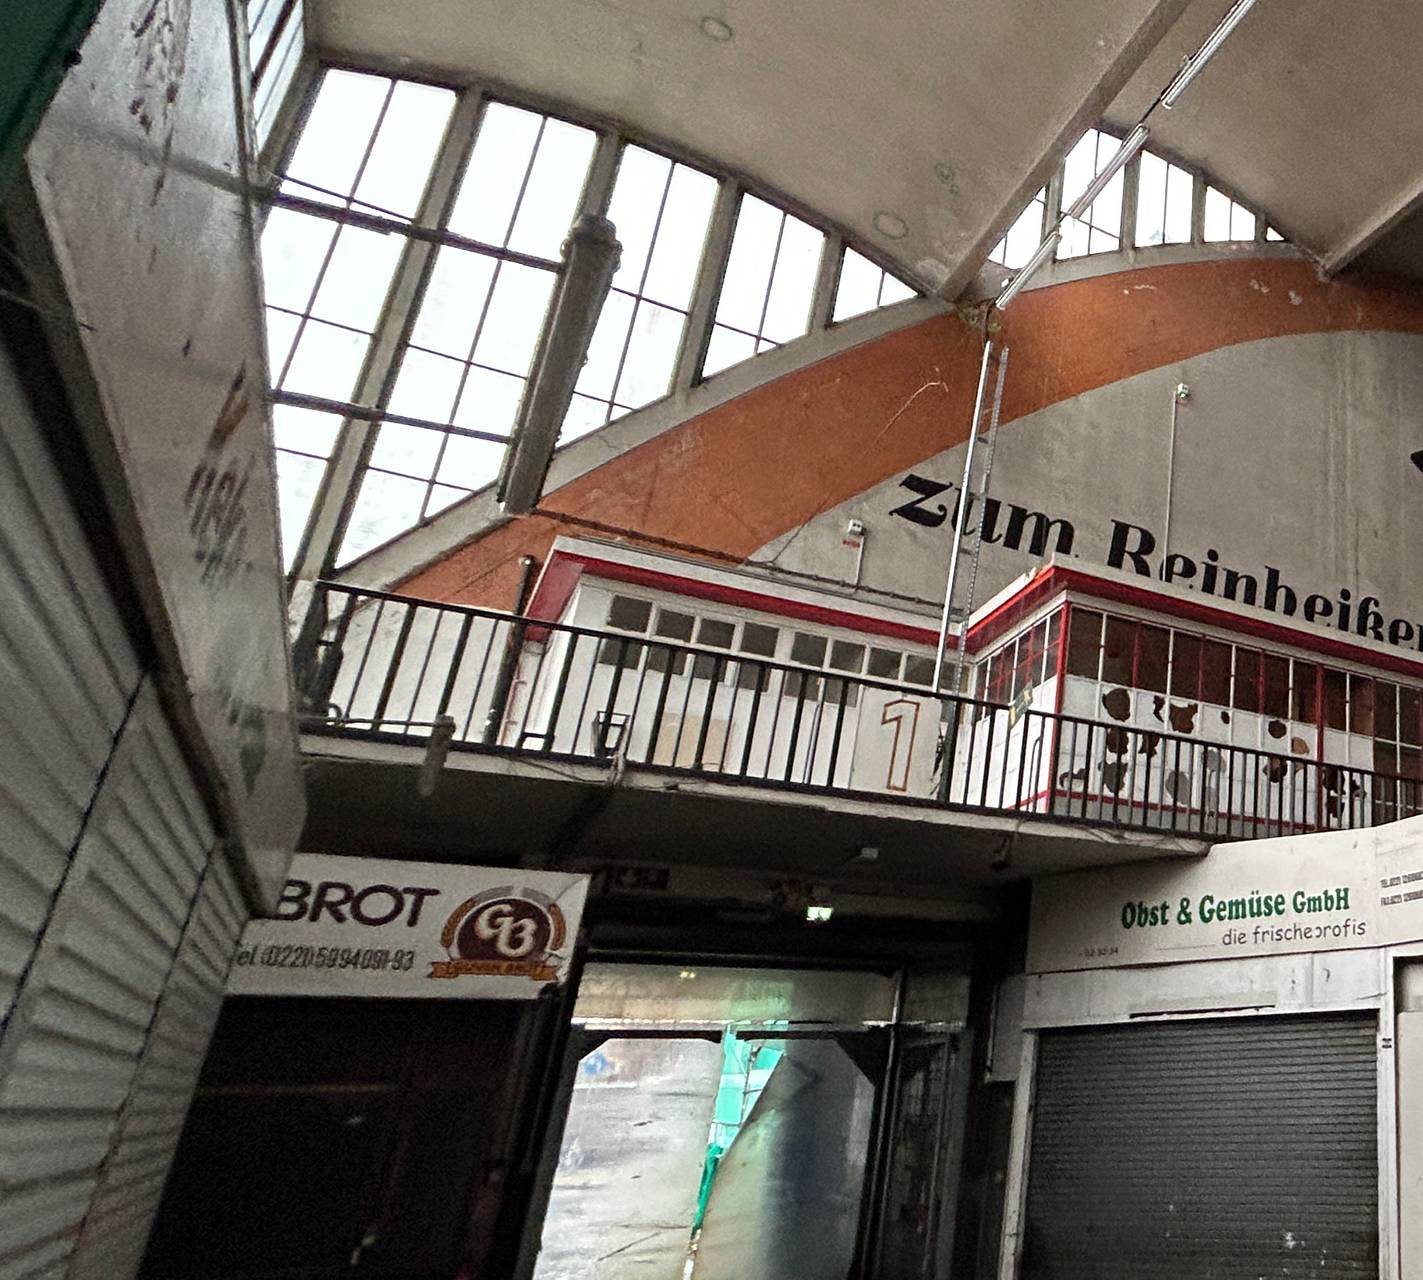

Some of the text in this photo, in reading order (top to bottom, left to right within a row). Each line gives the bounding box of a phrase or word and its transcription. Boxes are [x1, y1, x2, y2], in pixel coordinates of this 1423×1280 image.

[881, 699, 920, 792] 1
[274, 878, 440, 927] BROT
[1121, 900, 1170, 929] Obst
[1177, 897, 1192, 925] &
[1199, 890, 1286, 924] Gemüse
[1292, 887, 1350, 914] GmbH
[1222, 928, 1247, 946] die
